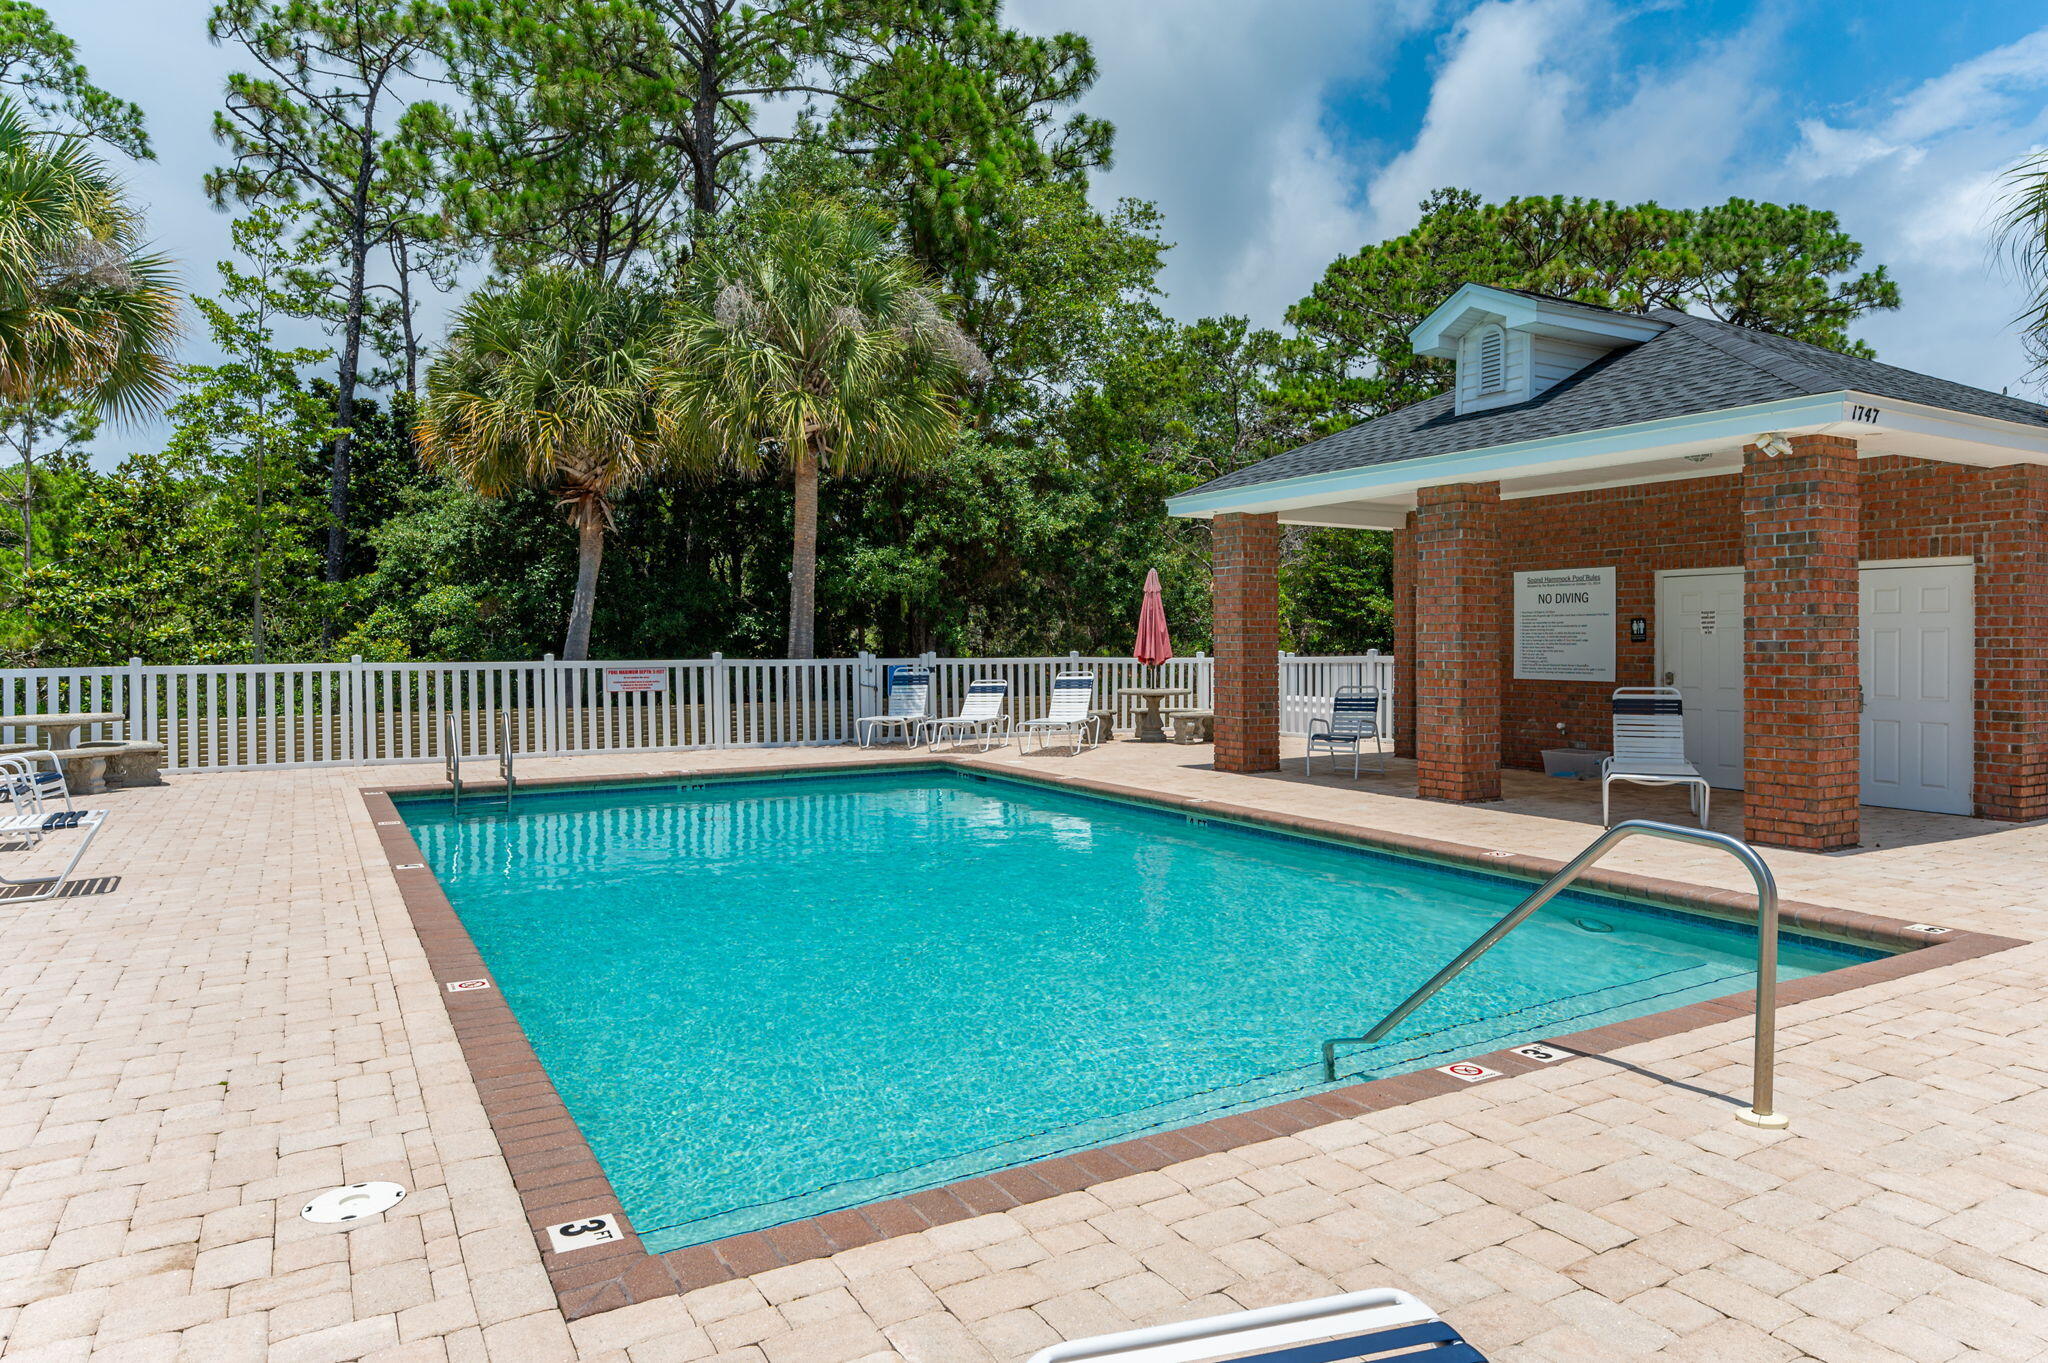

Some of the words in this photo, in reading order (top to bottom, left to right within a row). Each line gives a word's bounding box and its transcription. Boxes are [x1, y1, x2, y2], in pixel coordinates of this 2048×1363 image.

[1852, 405, 1880, 424] 1747
[1572, 574, 1584, 582] Pool
[1584, 573, 1600, 581] Rules
[1538, 593, 1552, 604] NO
[1555, 592, 1589, 604] DIVING
[1521, 1049, 1553, 1059] 3
[559, 1219, 606, 1237] 3
[594, 1230, 613, 1240] FT
